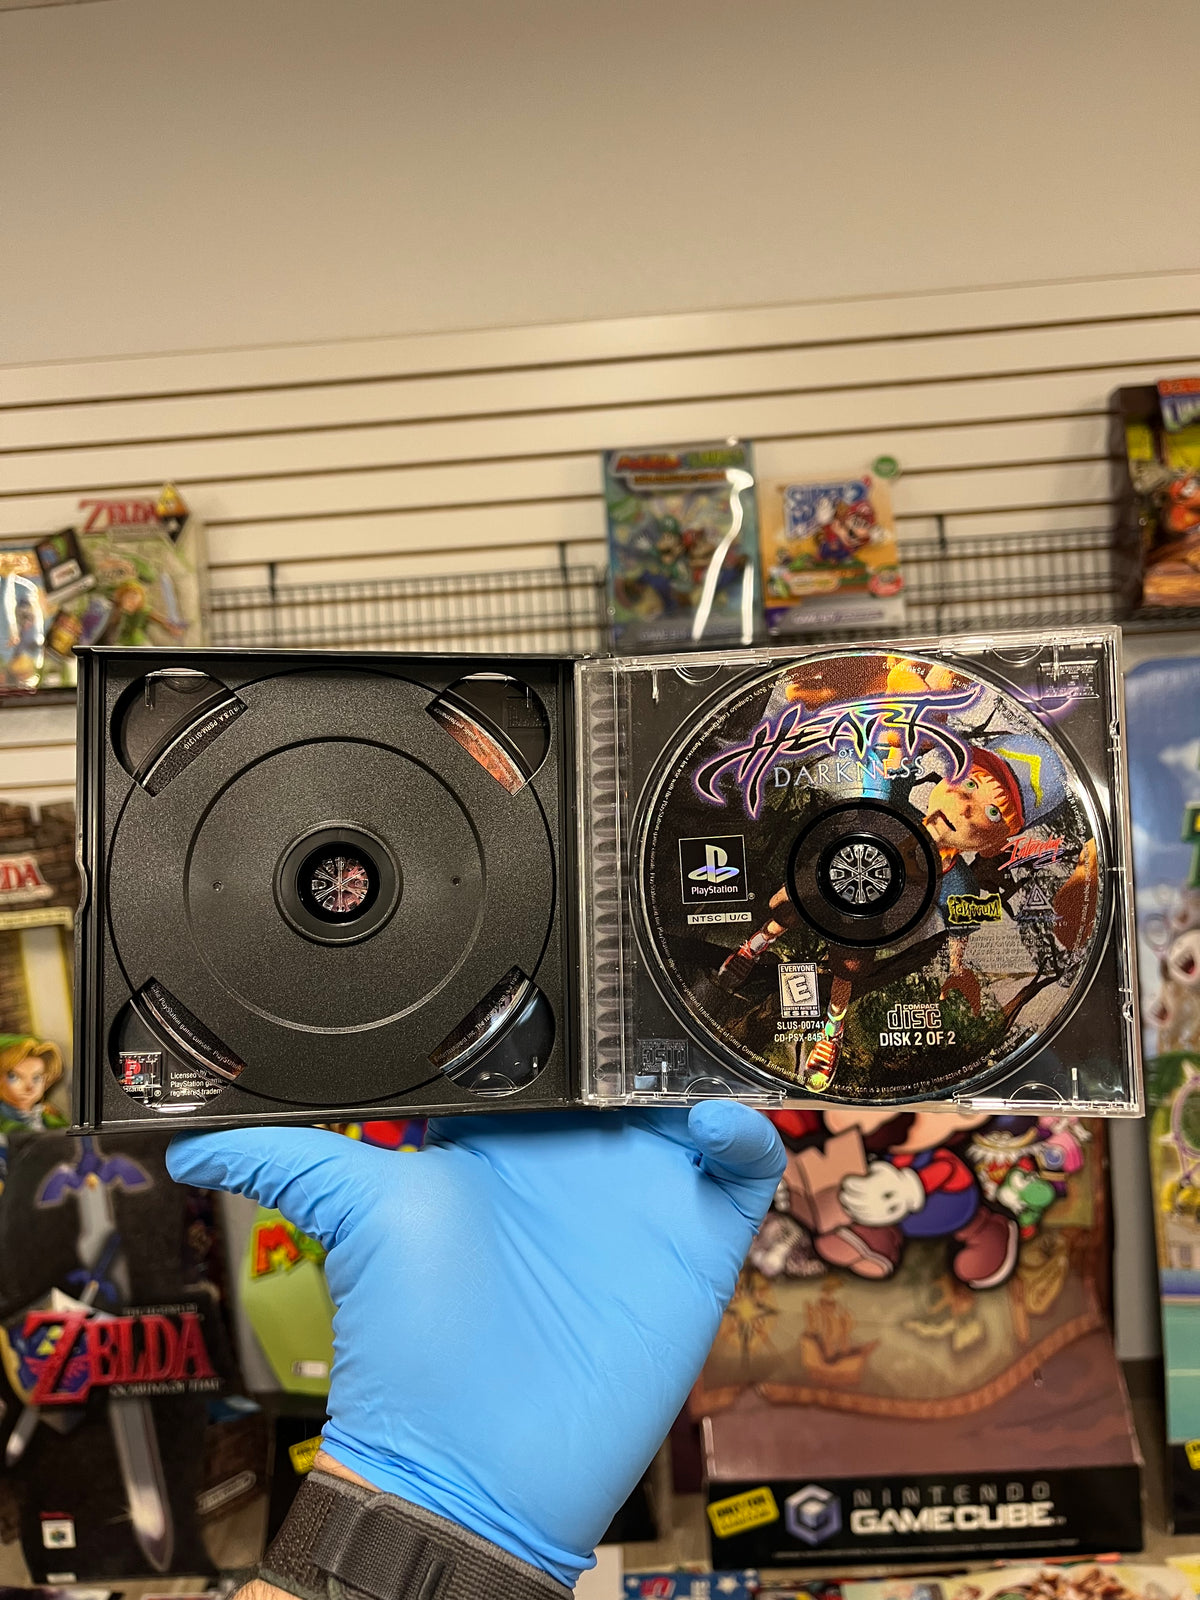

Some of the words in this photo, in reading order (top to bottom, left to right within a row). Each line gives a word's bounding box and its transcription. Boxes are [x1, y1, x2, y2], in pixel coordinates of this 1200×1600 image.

[695, 684, 984, 819] HEART
[838, 749, 854, 758] OF
[773, 756, 925, 788] DARKNESS
[998, 834, 1067, 871] Interplay
[691, 885, 739, 896] PlayStation
[692, 914, 722, 923] NTSC
[729, 913, 748, 921] U/C
[780, 964, 815, 973] EVERYONE
[788, 976, 812, 1003] E
[160, 997, 181, 1026] PlayStation
[887, 1003, 942, 1030] disc
[777, 1021, 825, 1030] SLUS-00741
[879, 1032, 911, 1047] DISK
[914, 1033, 922, 1046] 2
[926, 1031, 945, 1046] OF
[948, 1031, 956, 1044] 2
[170, 1072, 197, 1080] Licensed
[740, 1044, 767, 1065] Computer
[930, 1068, 962, 1084] Interactive
[961, 1058, 982, 1073] Digital
[170, 1080, 204, 1088] PlayStation
[23, 1309, 217, 1405] ZELDA
[852, 1480, 1052, 1508] NINTENDO
[850, 1501, 1056, 1536] GAMECUBE
